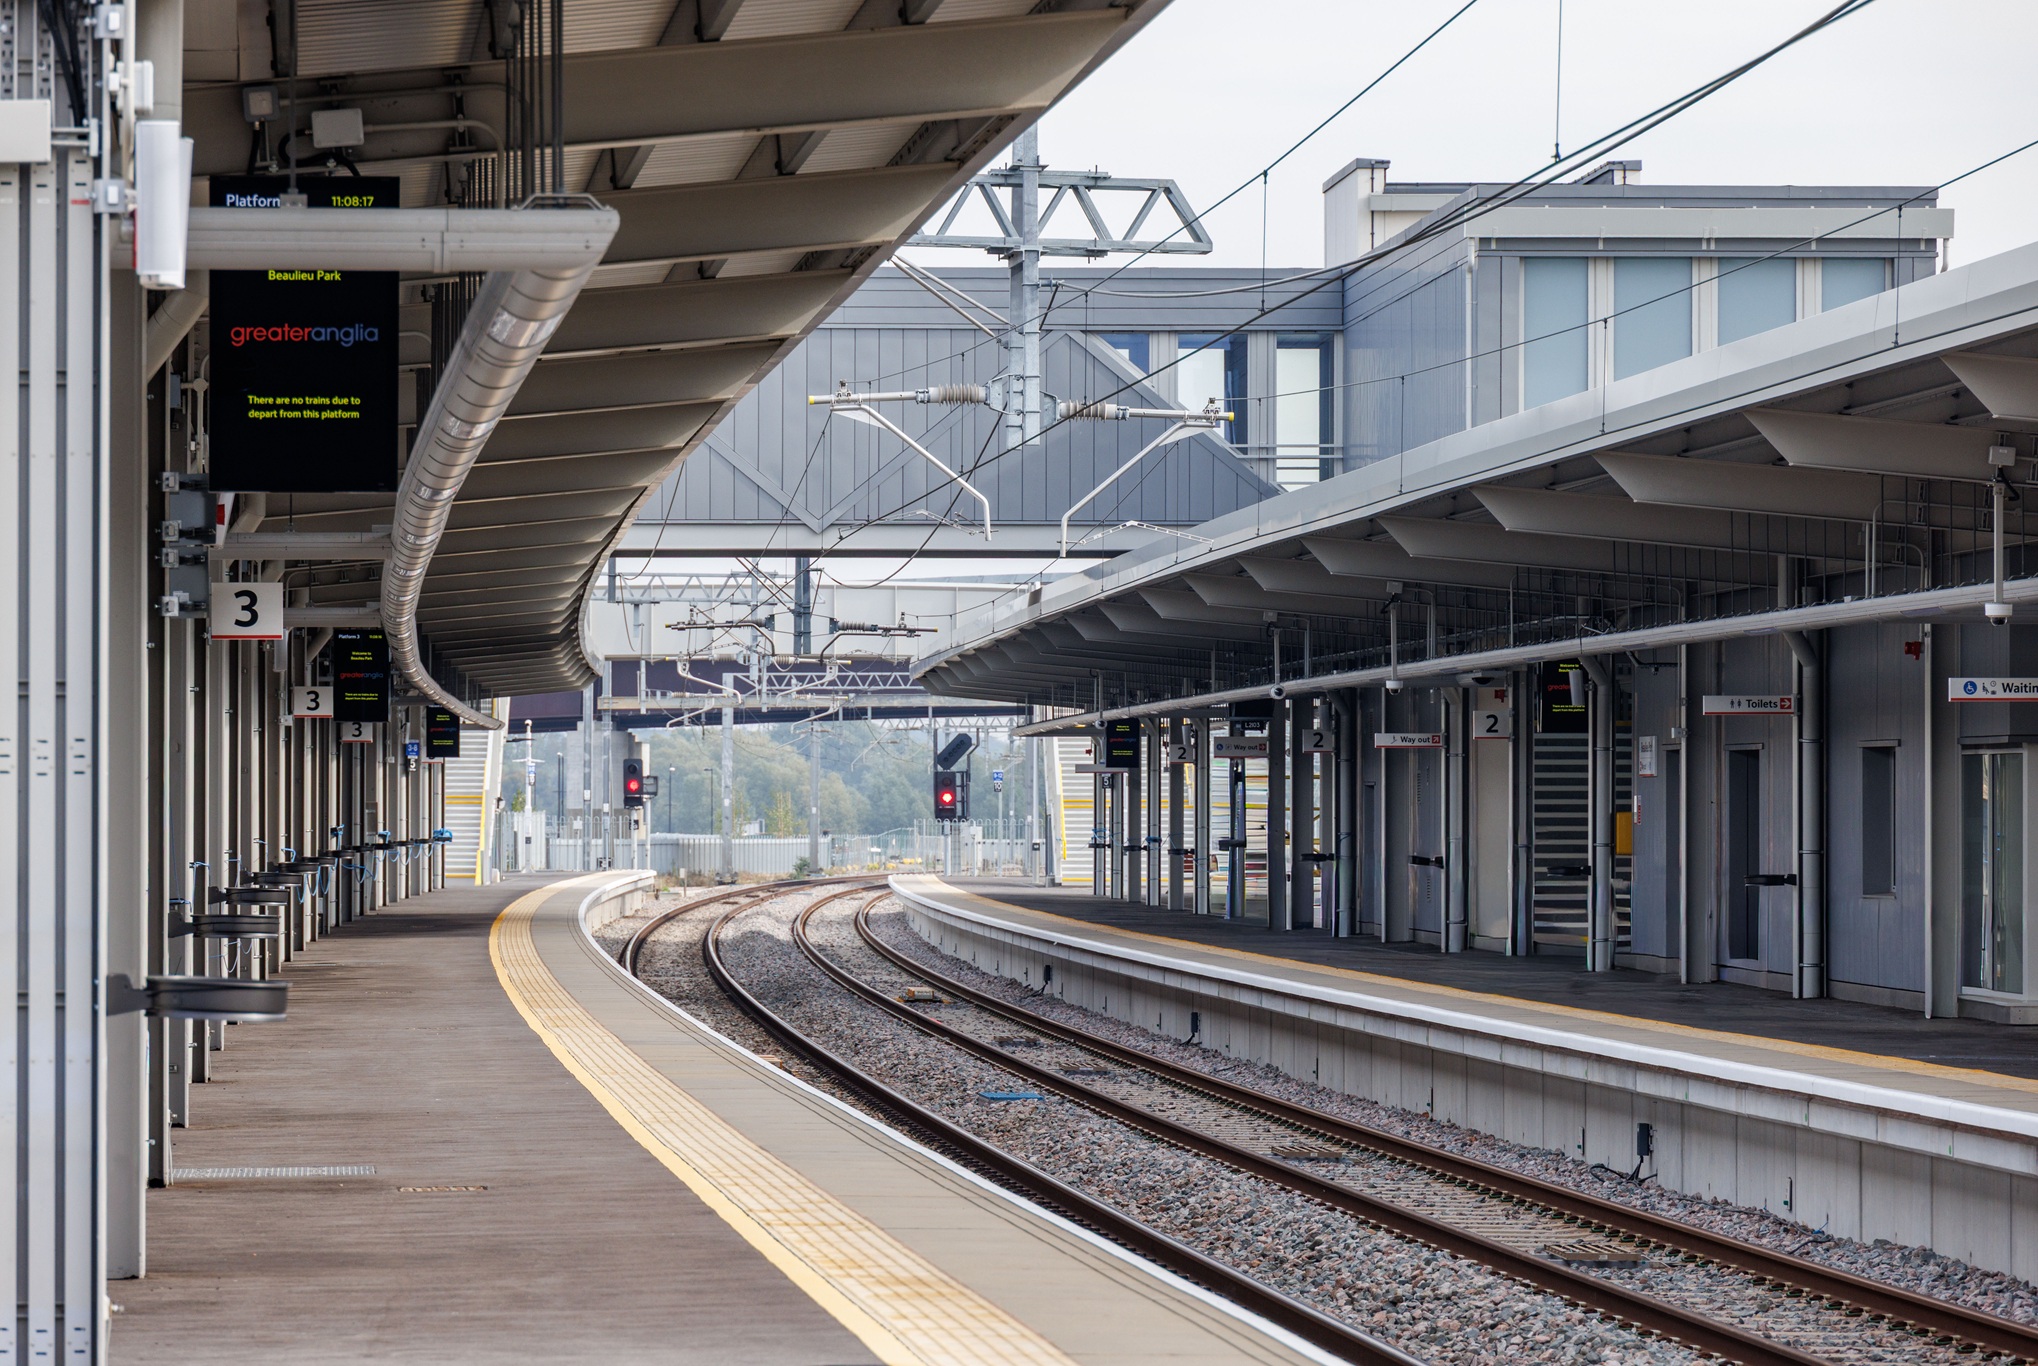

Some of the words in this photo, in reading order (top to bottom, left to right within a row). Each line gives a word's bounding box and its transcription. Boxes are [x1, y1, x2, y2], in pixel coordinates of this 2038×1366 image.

[332, 195, 374, 207] 11:08:17
[268, 269, 315, 281] Beaulieu
[317, 269, 341, 281] Park
[230, 323, 379, 348] greateranglia
[247, 395, 274, 405] There
[275, 397, 290, 405] are
[292, 397, 304, 405] no
[305, 396, 330, 405] trains
[332, 396, 349, 405] due
[350, 396, 361, 405] to
[248, 409, 278, 420] depart
[279, 409, 301, 418] from
[303, 409, 320, 418] this
[321, 409, 360, 420] platform
[234, 590, 258, 627] 3
[306, 690, 320, 711] 3
[1746, 699, 1778, 709] Toilets
[1486, 714, 1499, 733] 2
[351, 722, 363, 738] 3
[1313, 731, 1324, 748] 2
[1400, 736, 1416, 745] Way
[407, 744, 418, 752] 3-8
[1177, 747, 1187, 760] 2
[410, 760, 416, 769] 5
[1103, 777, 1109, 786] 5
